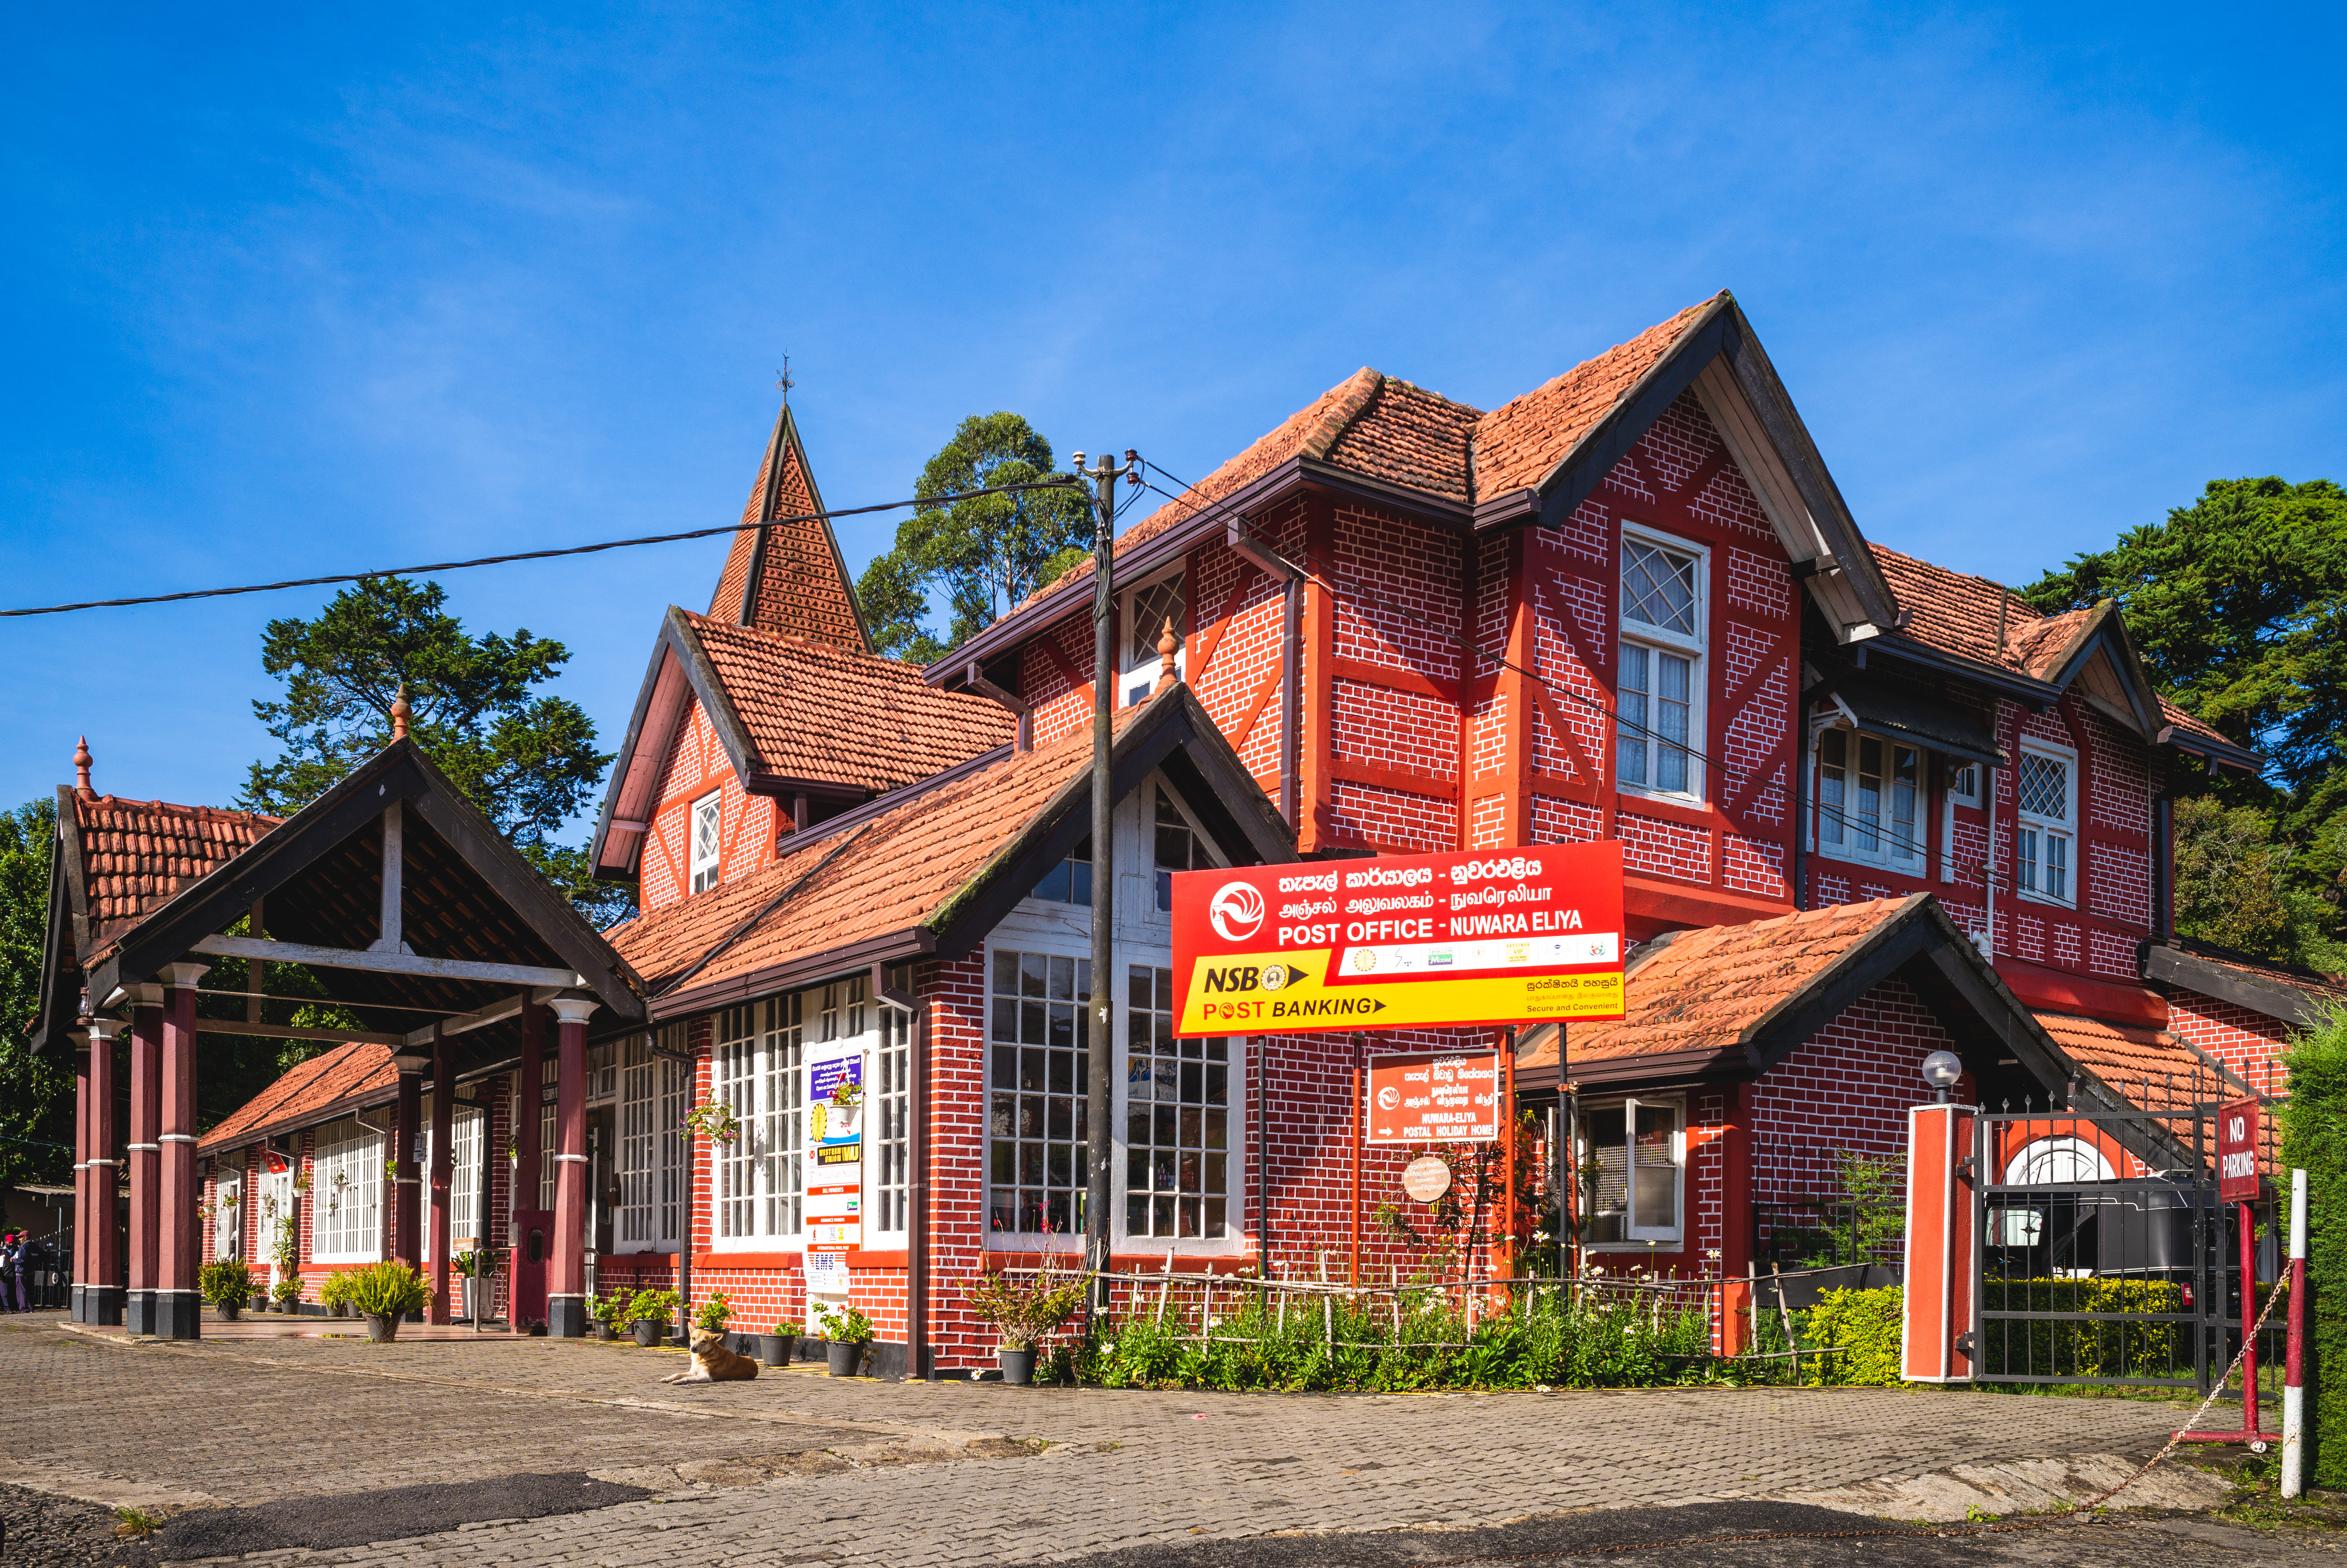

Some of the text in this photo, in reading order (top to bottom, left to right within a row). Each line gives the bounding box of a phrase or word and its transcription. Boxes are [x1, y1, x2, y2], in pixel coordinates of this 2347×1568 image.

[1278, 870, 1338, 892] තැපැල්
[1451, 857, 1542, 885] නුවරඑළිය
[1278, 897, 1337, 920] அஞ்சல்
[1345, 890, 1434, 915] அலுவலகம்
[1451, 883, 1552, 911] நுவரெலியா
[1278, 923, 1341, 946] POST
[1347, 918, 1433, 941] OFFICE
[1451, 913, 1528, 936] NUWARA
[1532, 910, 1583, 932] ELIYA
[1429, 956, 1451, 964] Mobitel
[1203, 967, 1259, 993] NSB
[1583, 977, 1618, 989] පහසුයි
[1272, 998, 1372, 1017] BANKING
[1405, 1069, 1429, 1083] තැපැල්
[1433, 1069, 1454, 1082] නිවාඩු
[1431, 1083, 1468, 1098] நுவரெலியா
[1404, 1092, 1493, 1108] அஞ்சல் விடுமுறை விடுதி
[1422, 1112, 1476, 1124] NUWARA-ELIYA
[1403, 1124, 1493, 1137] POSTAL HOLIDAY HOME
[2229, 1116, 2245, 1143] NO
[819, 1147, 841, 1156] WESTERN
[825, 1155, 841, 1163] UNION
[842, 1146, 859, 1161] WU
[2223, 1151, 2254, 1179] PARKING
[815, 1254, 833, 1270] EMS
